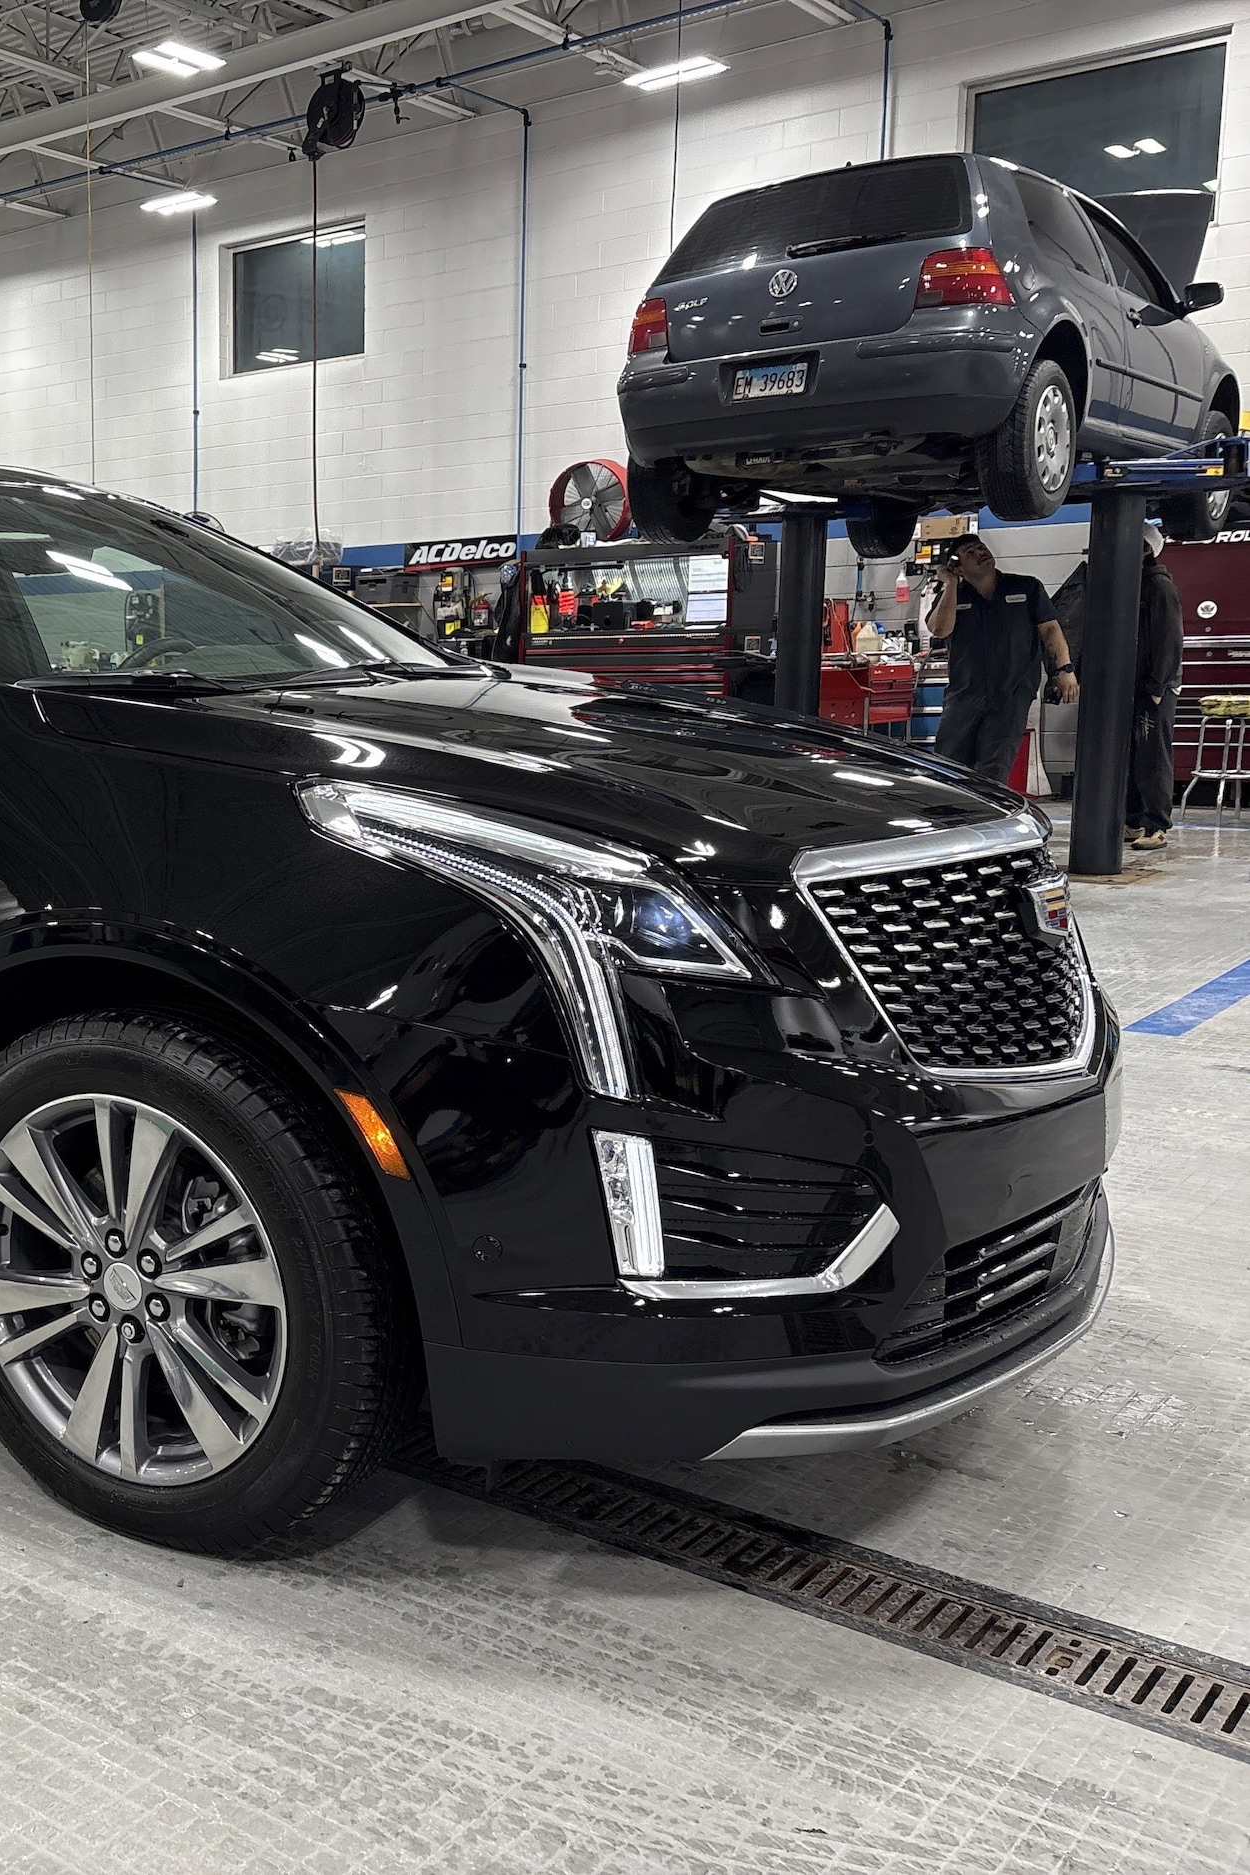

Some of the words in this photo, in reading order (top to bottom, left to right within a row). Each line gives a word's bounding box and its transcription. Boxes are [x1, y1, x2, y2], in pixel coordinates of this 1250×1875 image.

[734, 376, 753, 396] EM
[759, 369, 805, 392] 39683
[408, 540, 517, 565] ACDelco
[307, 1334, 322, 1384] TOUR
